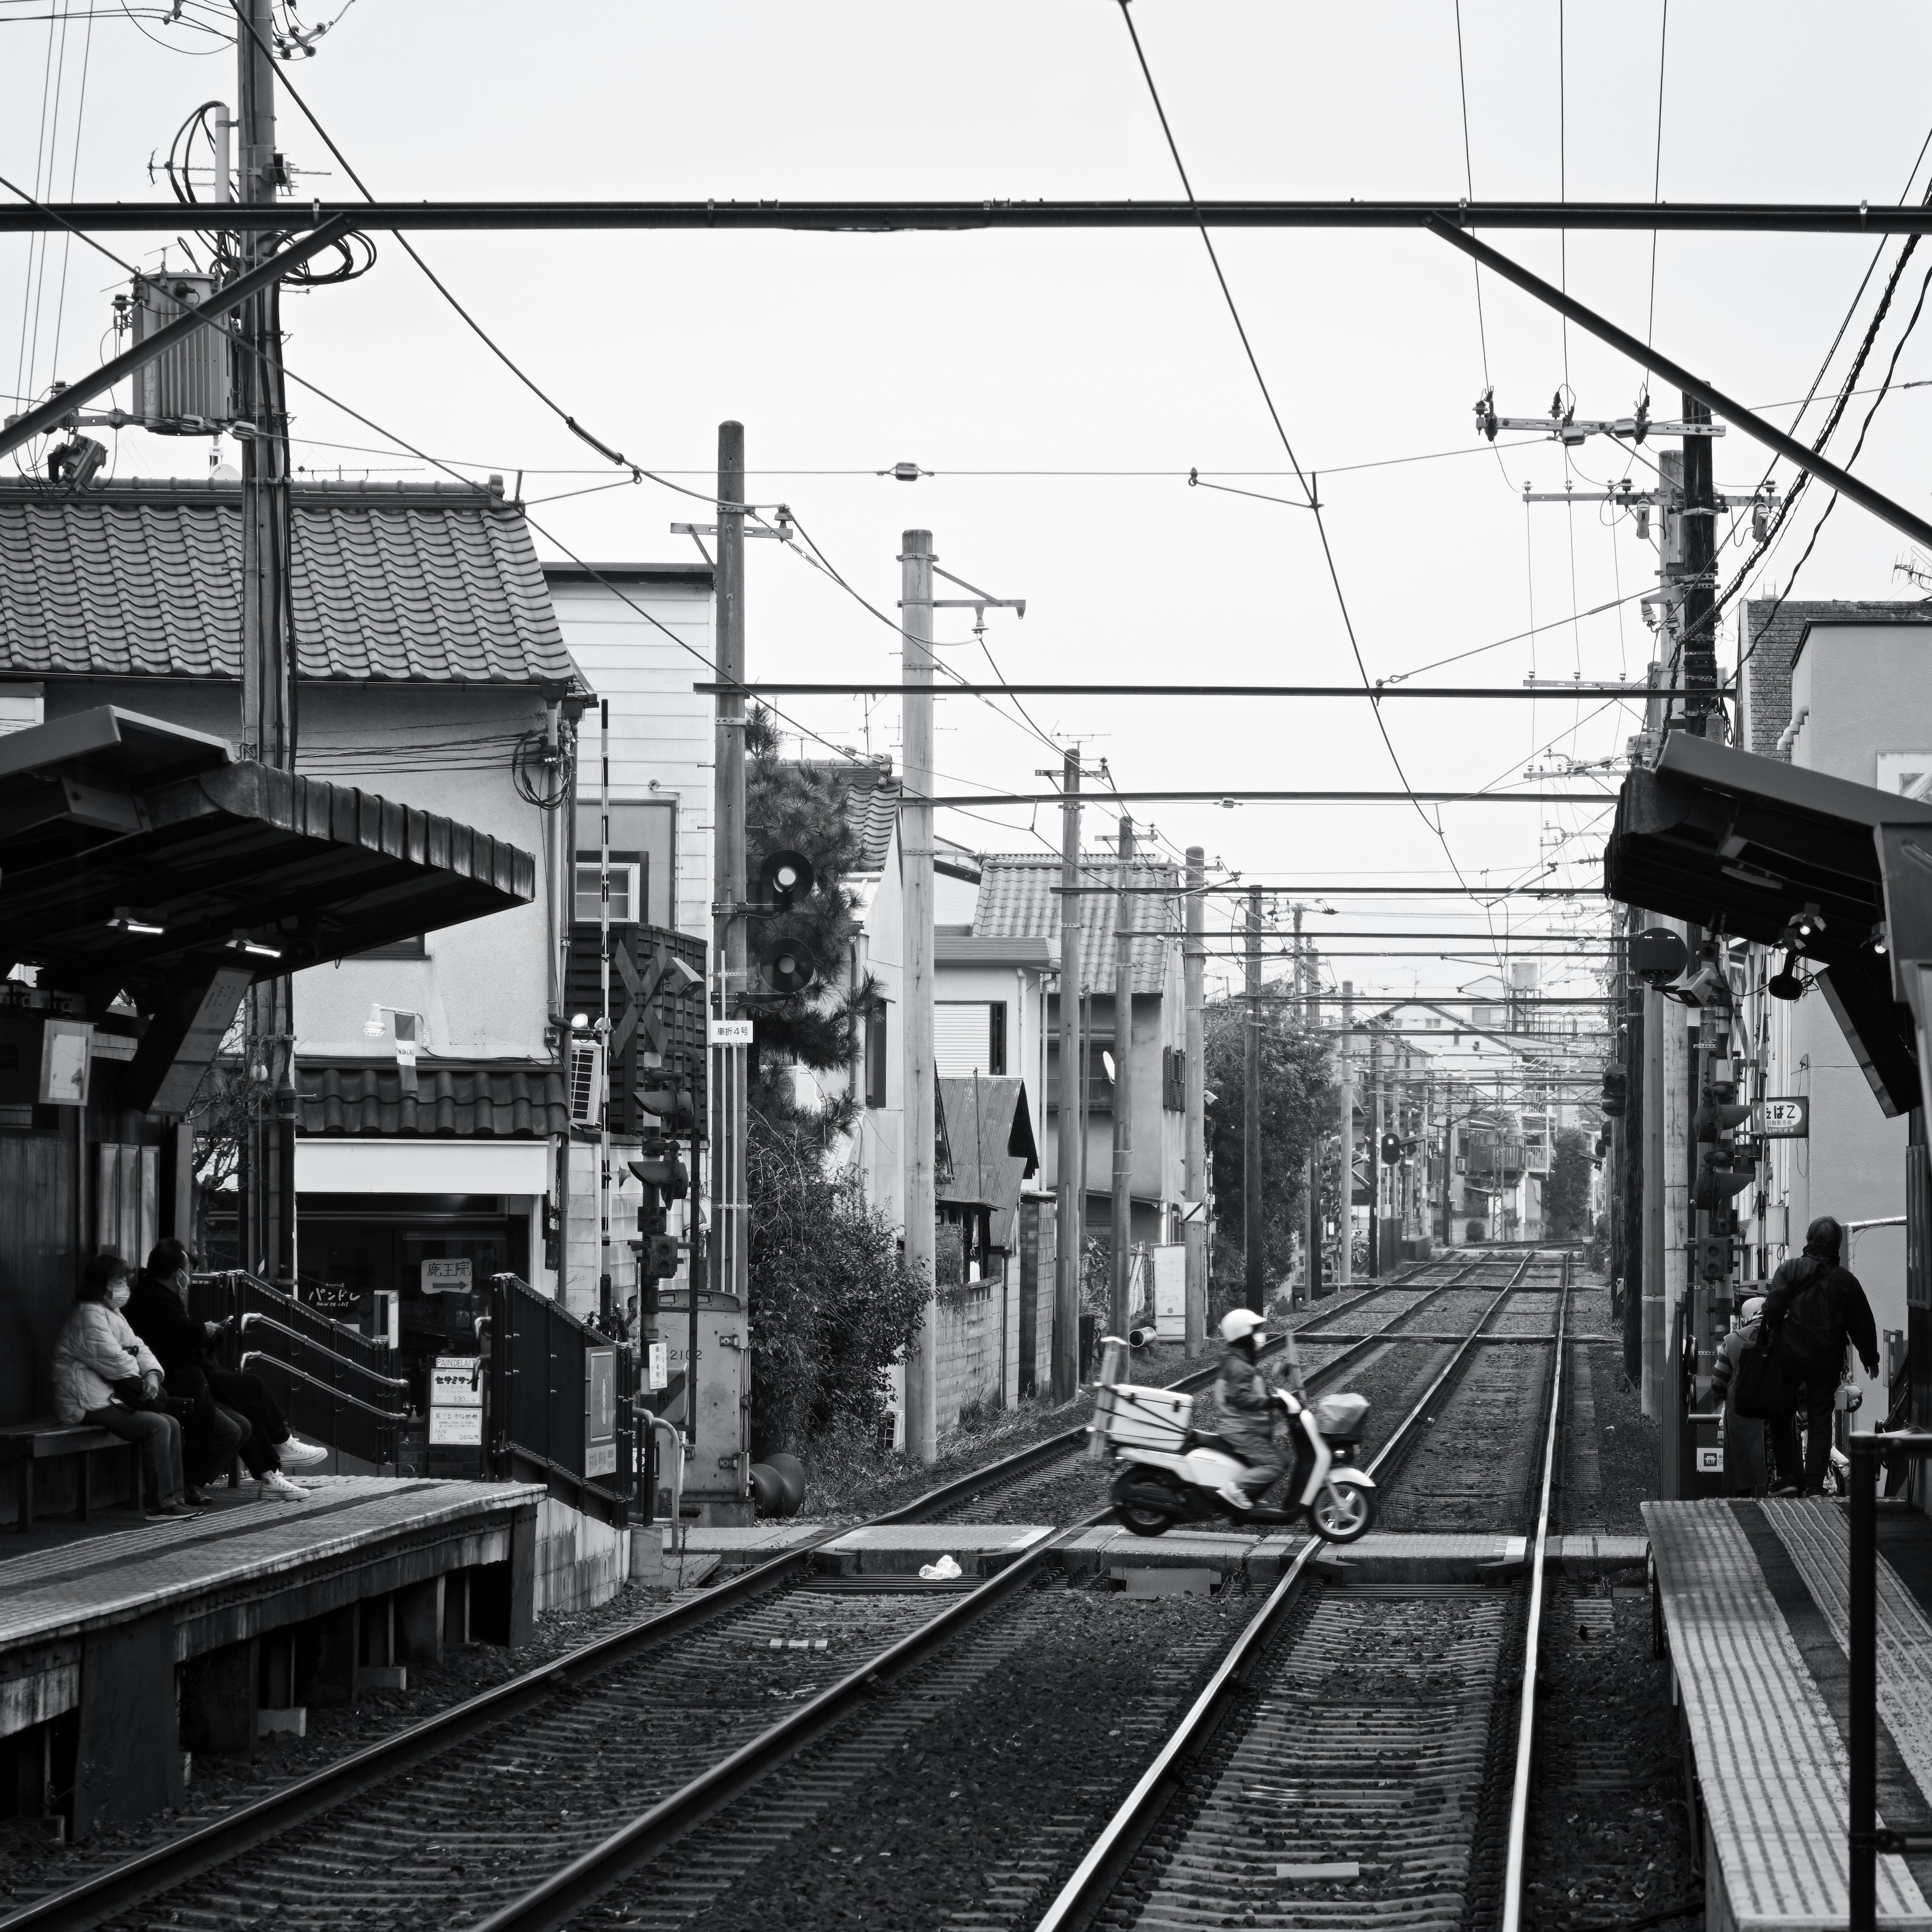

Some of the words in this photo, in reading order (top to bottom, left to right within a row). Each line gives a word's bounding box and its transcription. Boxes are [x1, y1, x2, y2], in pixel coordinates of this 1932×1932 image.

[717, 1027, 748, 1035] 車折4号
[427, 1261, 471, 1276] 鹿王院
[309, 1287, 360, 1301] パンドレ
[435, 1376, 479, 1385] セサミサン
[1717, 1430, 1724, 1439] 鹿
